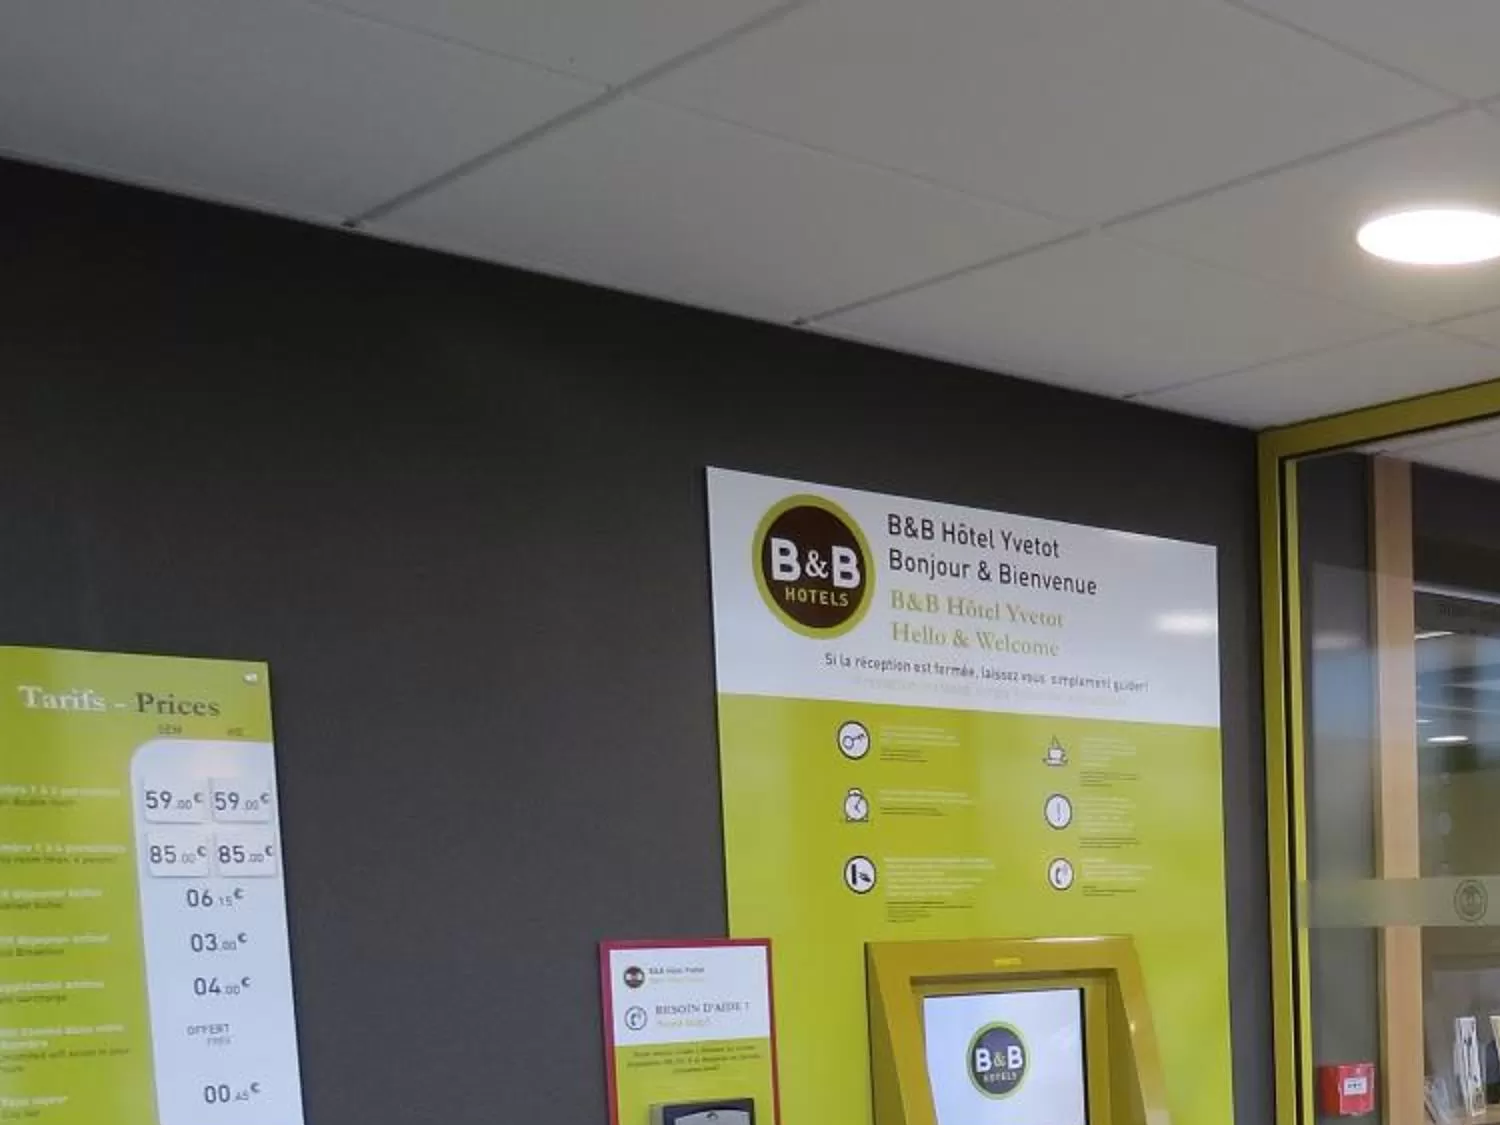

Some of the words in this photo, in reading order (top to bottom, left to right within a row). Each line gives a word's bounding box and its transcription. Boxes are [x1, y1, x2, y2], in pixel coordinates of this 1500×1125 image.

[888, 513, 936, 542] B&B
[942, 522, 995, 550] Hôtel
[1001, 531, 1061, 559] Yvetot
[770, 538, 861, 589] B&B
[888, 549, 971, 581] Bonjour
[977, 561, 992, 582] &
[1000, 564, 1097, 596] Bienvenue
[785, 587, 849, 608] HOTELS
[890, 589, 940, 613] B&B
[947, 595, 1000, 620] Hôtel
[1004, 604, 1065, 629] Yvetot
[892, 622, 946, 646] Hello
[952, 630, 969, 649] &
[976, 630, 1061, 657] Welcome
[825, 652, 837, 666] Si
[840, 653, 851, 668] la
[855, 656, 911, 673] réception
[914, 662, 931, 673] est
[17, 685, 106, 711] Tarifs
[136, 691, 221, 717] Prices
[975, 1045, 1023, 1073] B&B
